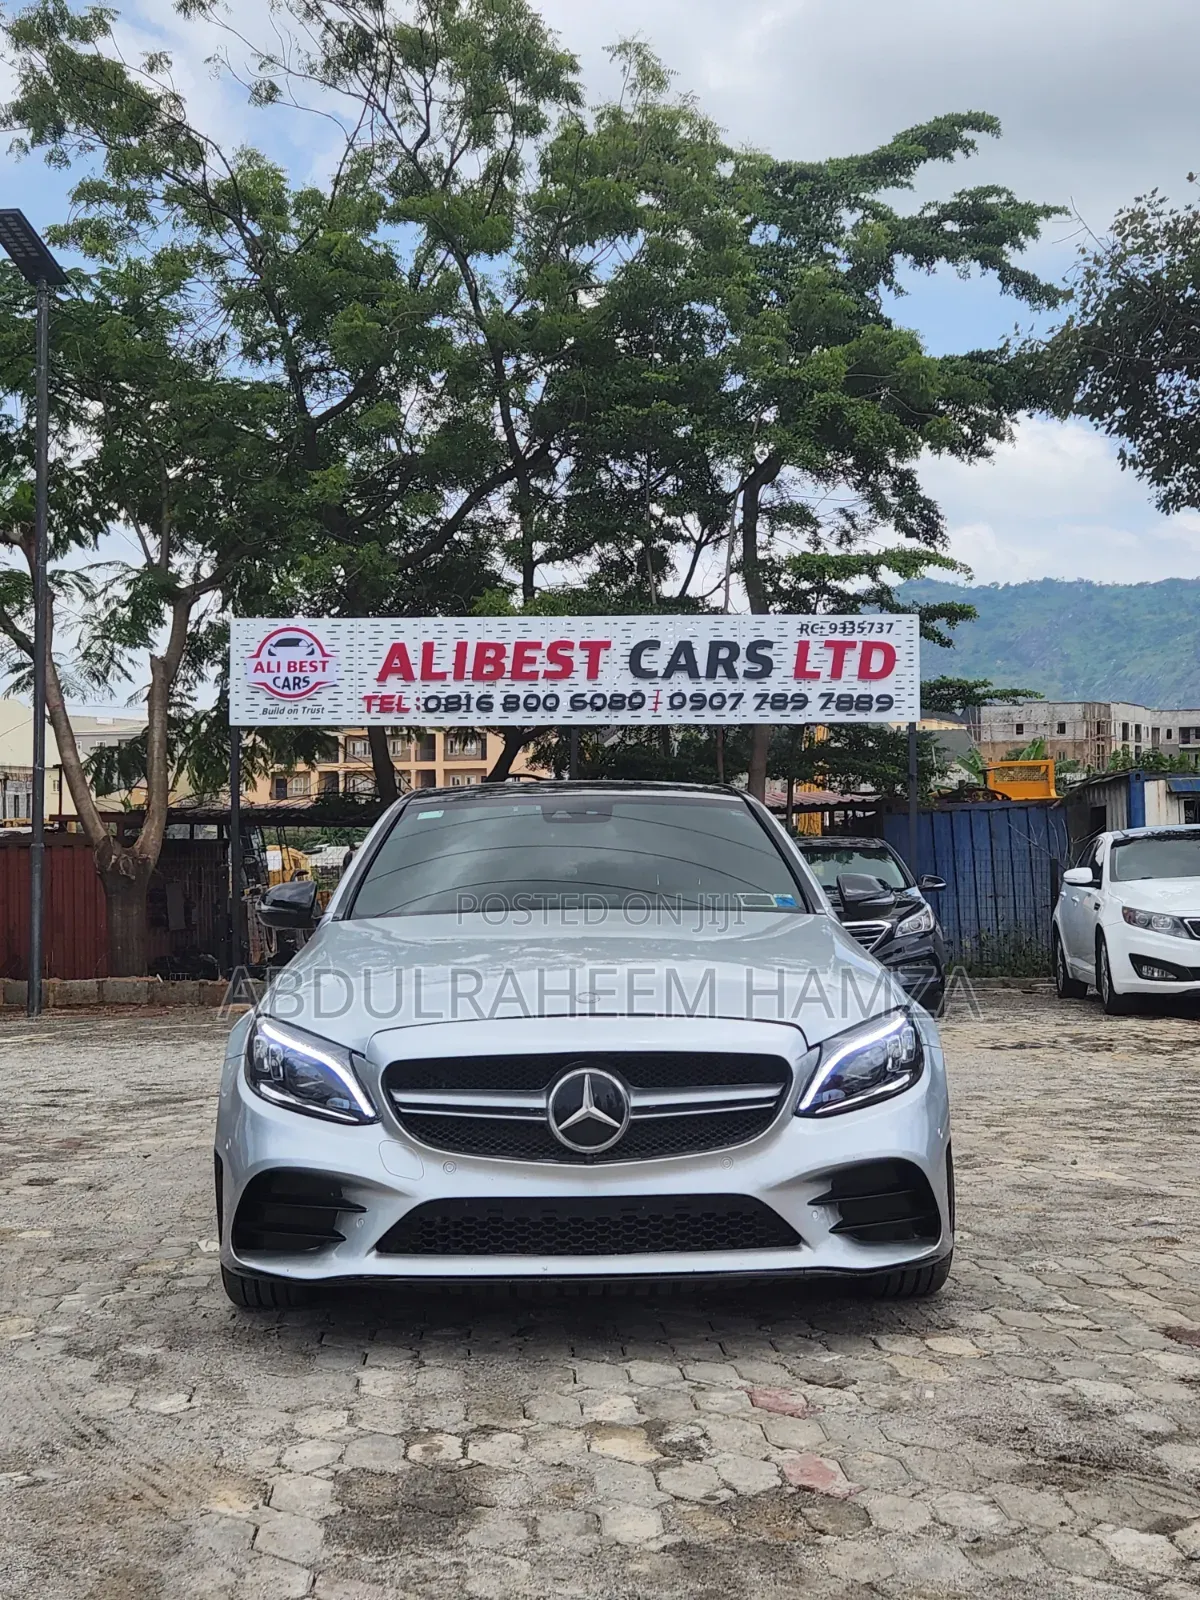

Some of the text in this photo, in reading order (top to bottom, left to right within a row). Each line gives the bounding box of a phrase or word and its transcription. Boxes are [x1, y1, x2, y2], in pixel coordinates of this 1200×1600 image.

[253, 660, 329, 673] ALI BEST
[376, 639, 896, 682] ALIBEST CARS LTD
[272, 676, 310, 691] CARS
[301, 706, 325, 714] Trust
[502, 693, 560, 713] 800
[569, 692, 646, 711] 6080
[668, 692, 744, 711] 0907
[752, 693, 808, 712] 789
[818, 693, 894, 712] 7889
